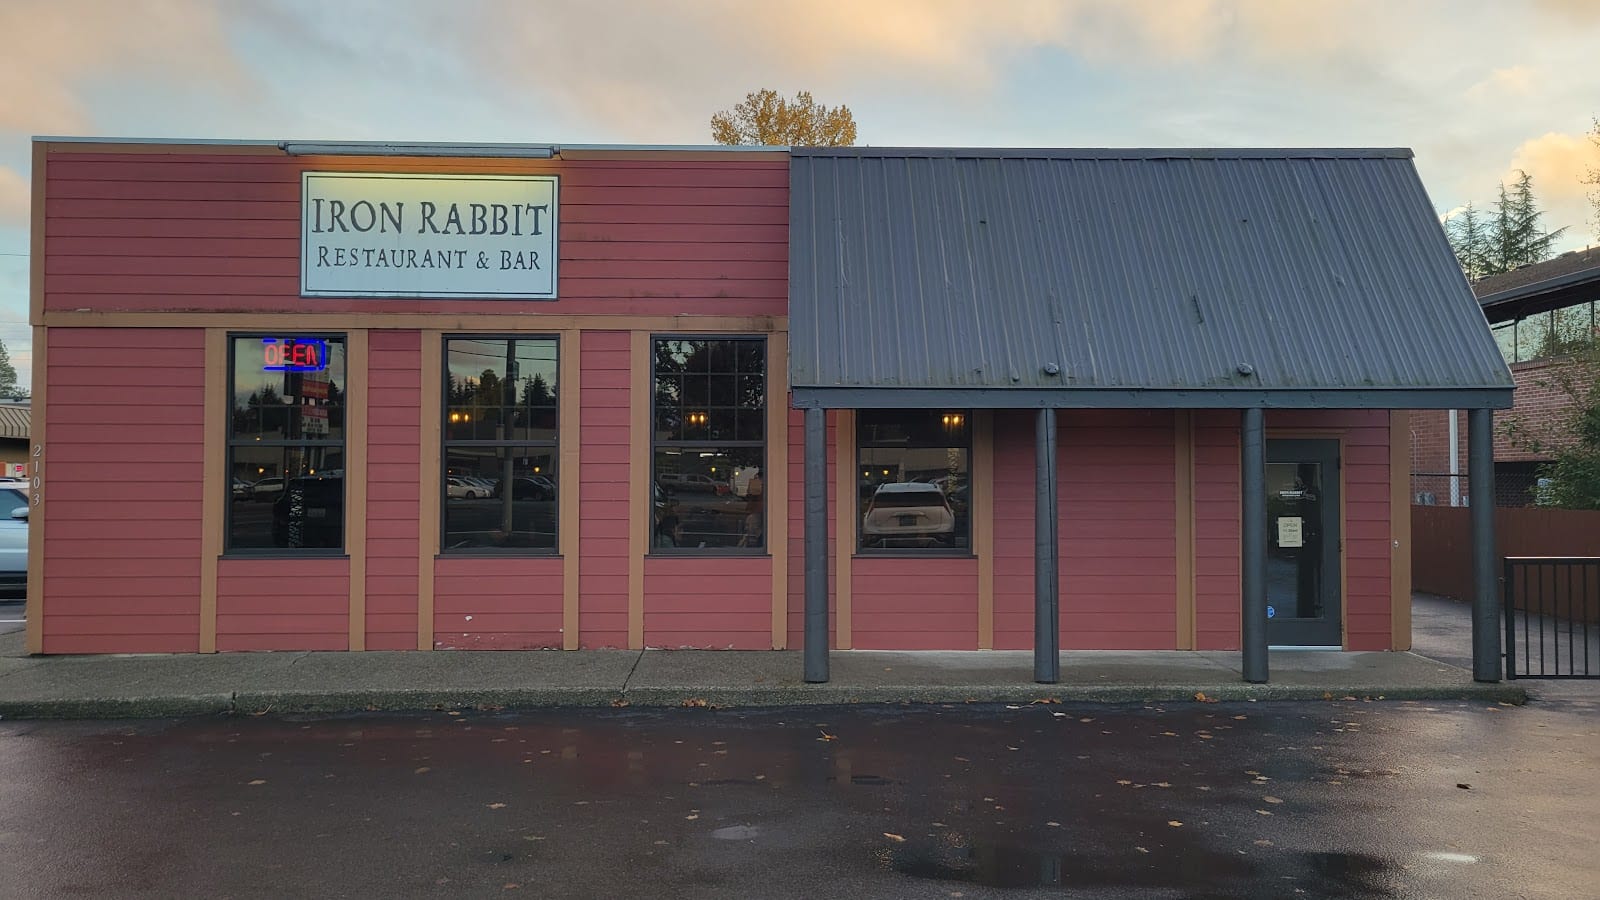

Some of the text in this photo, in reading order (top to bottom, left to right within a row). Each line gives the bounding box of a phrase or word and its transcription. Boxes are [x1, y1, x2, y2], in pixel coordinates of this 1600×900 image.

[312, 199, 547, 236] IRON RABBIT
[317, 246, 541, 270] RESTAURANT & BAR
[33, 444, 41, 506] 2103
